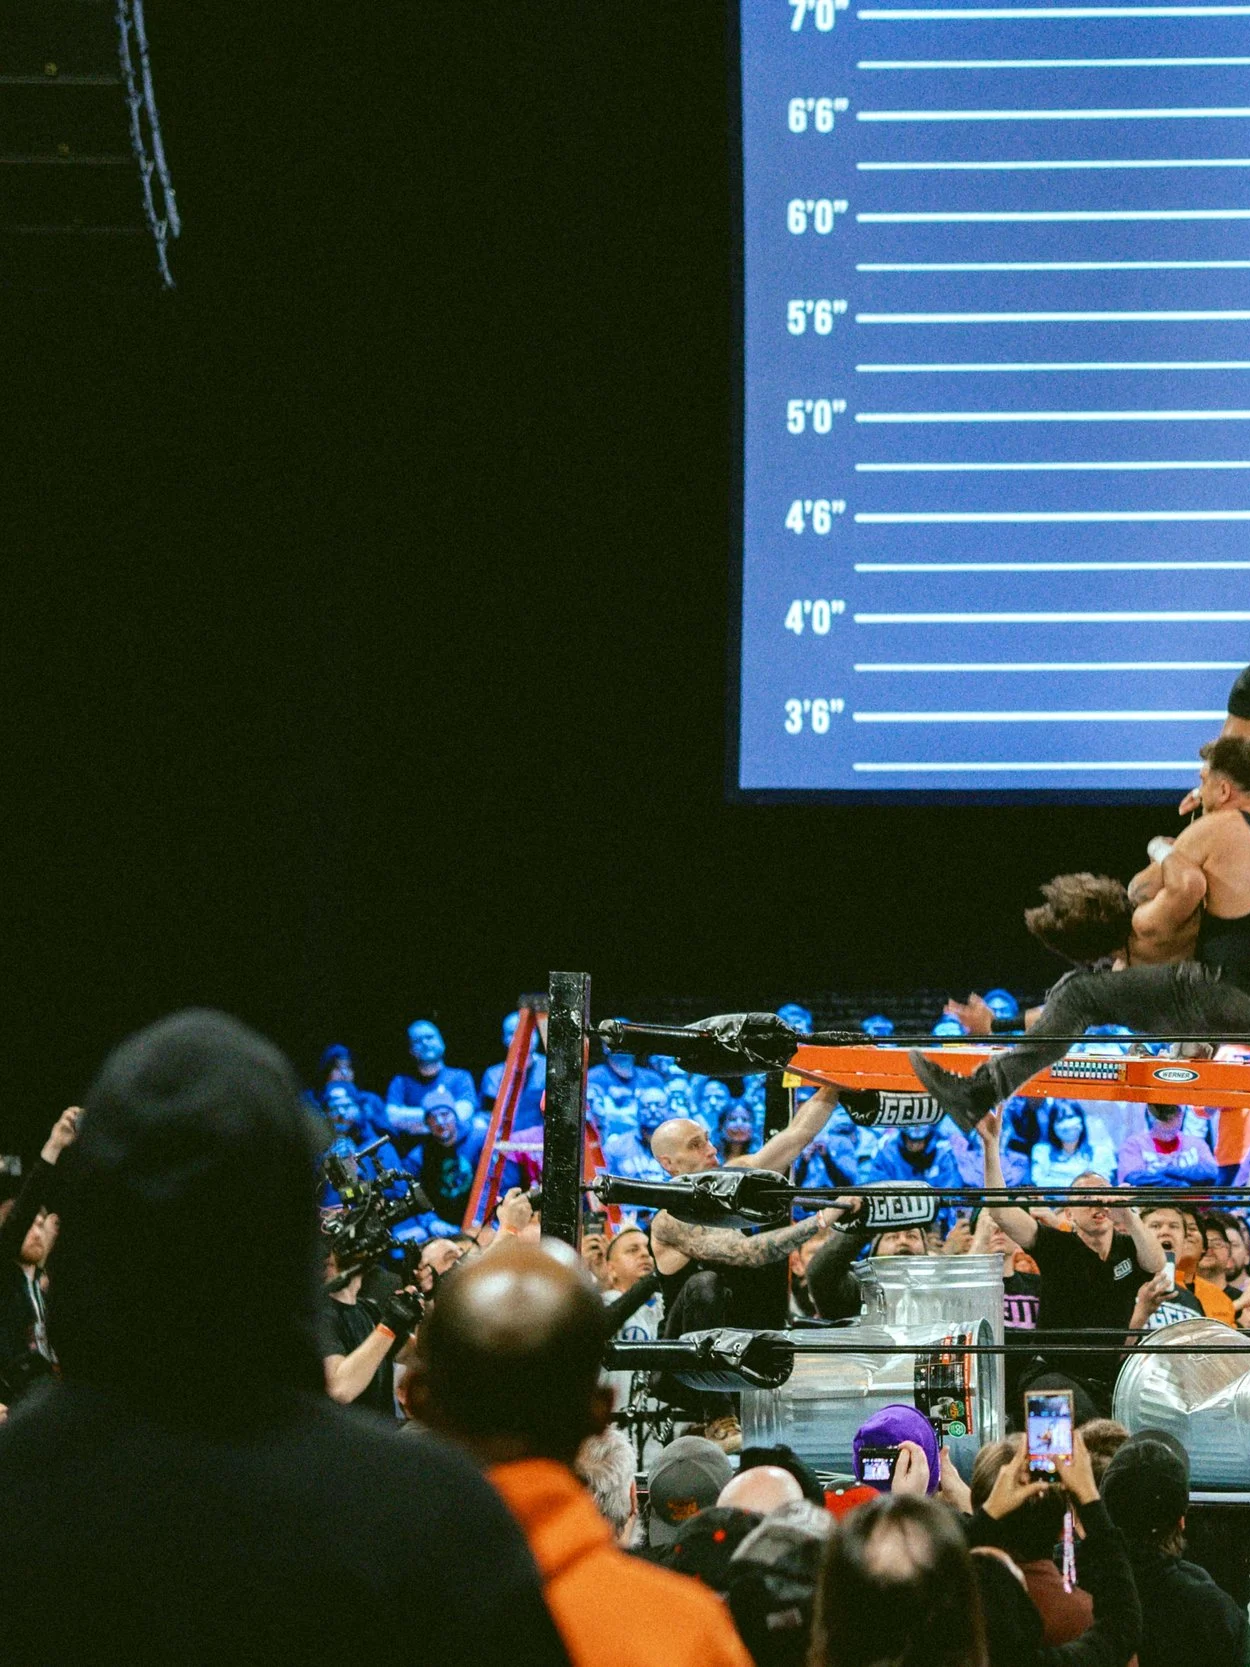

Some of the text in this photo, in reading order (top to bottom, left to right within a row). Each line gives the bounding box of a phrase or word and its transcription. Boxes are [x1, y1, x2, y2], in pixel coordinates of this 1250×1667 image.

[787, 97, 849, 133] 6'6"
[787, 199, 848, 235] 6'0"
[787, 299, 848, 335] 5'6"
[786, 399, 847, 434] 5'0"
[785, 499, 846, 535] 4'6"
[784, 599, 845, 635] 4'0"
[785, 698, 845, 734] 3'6"
[880, 1097, 938, 1124] GCW
[873, 1195, 930, 1221] GCW
